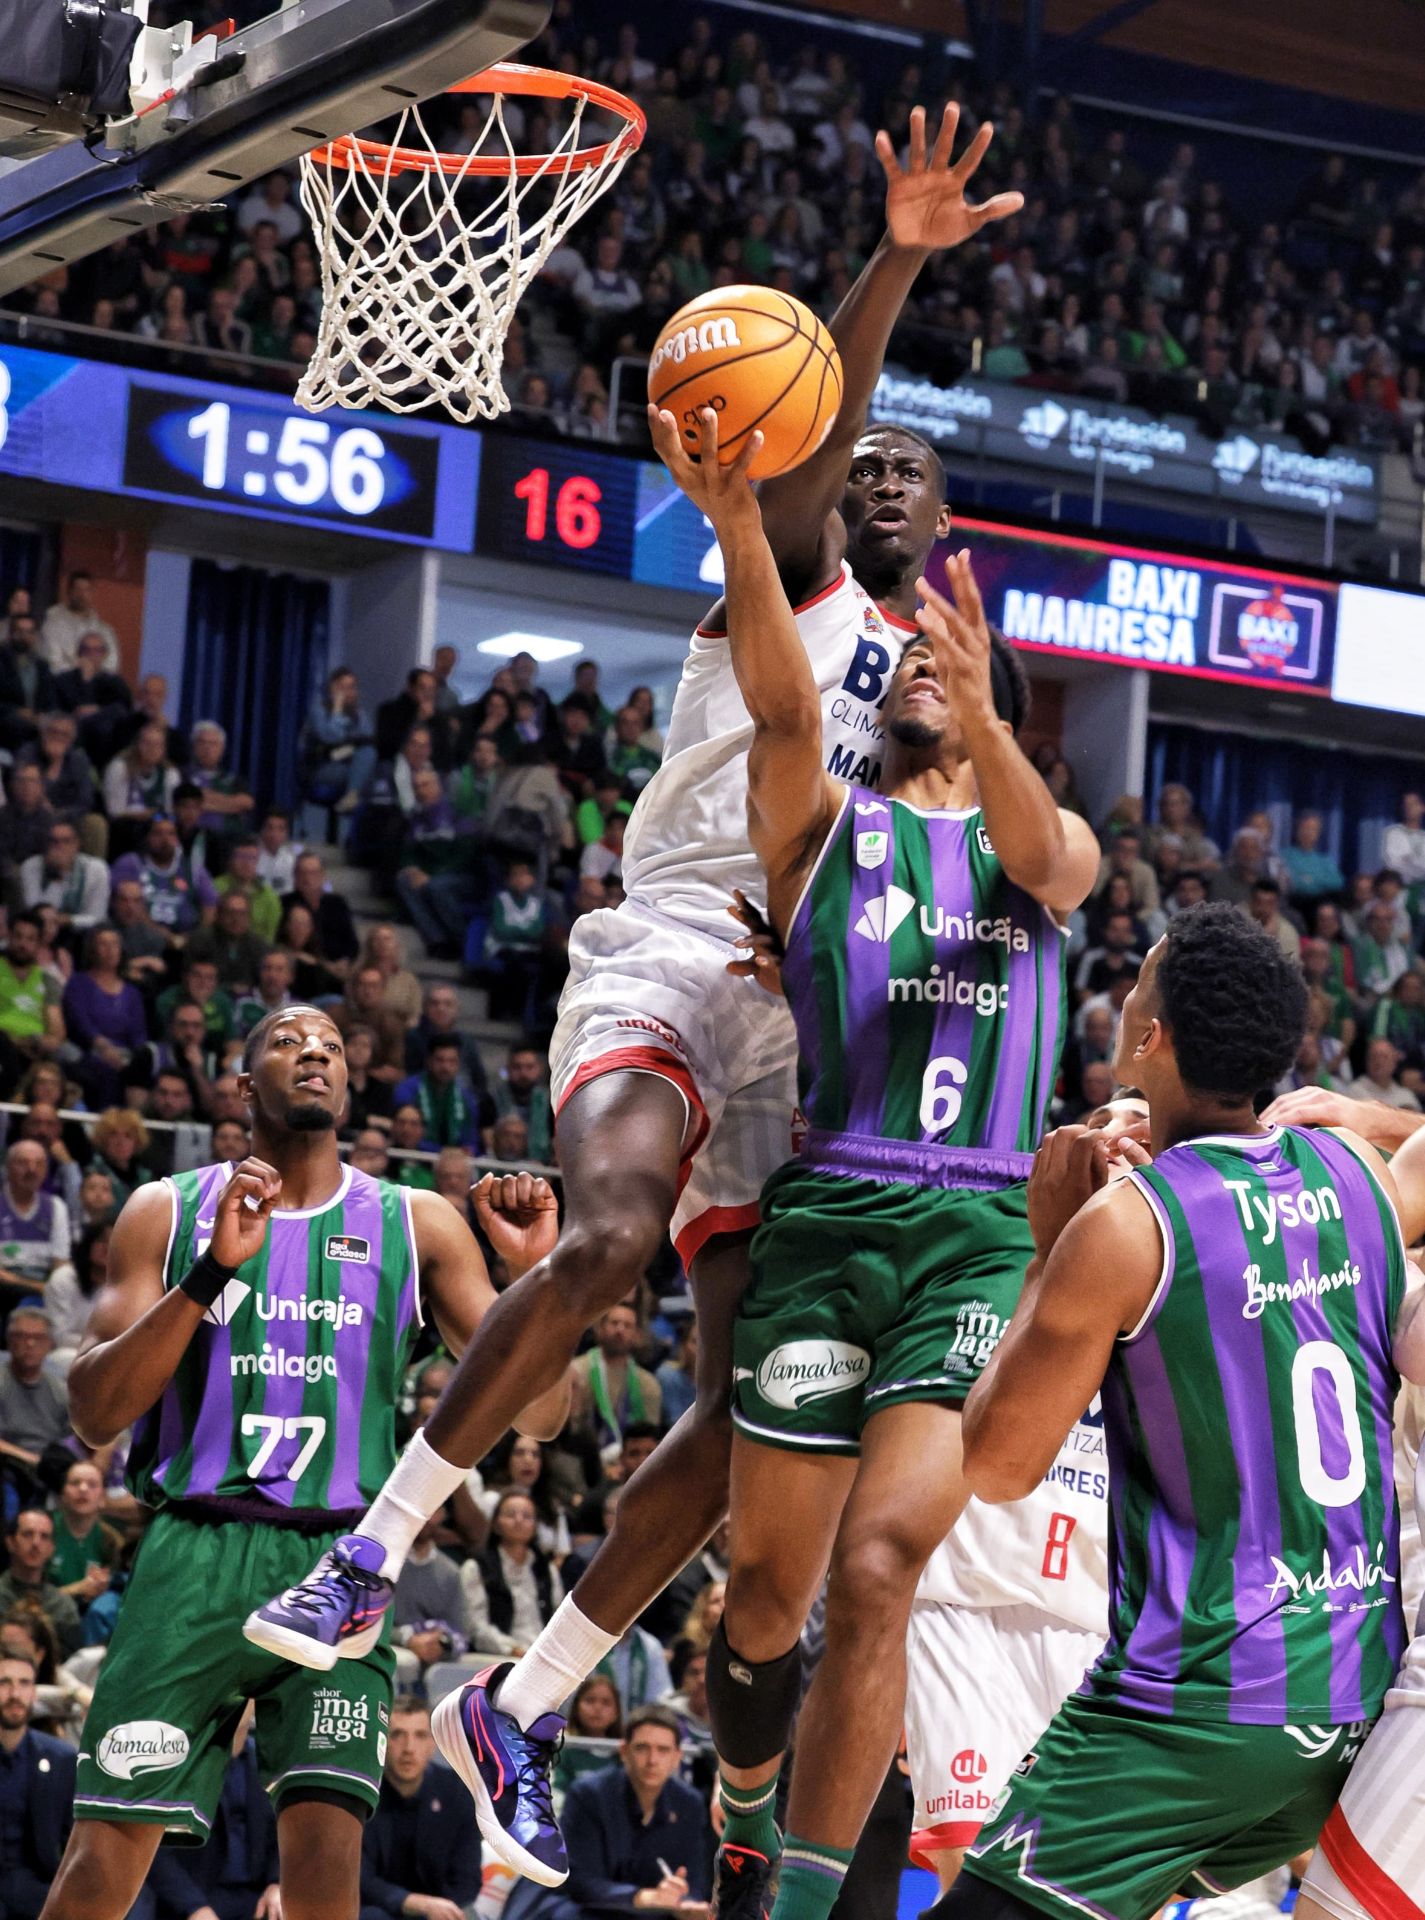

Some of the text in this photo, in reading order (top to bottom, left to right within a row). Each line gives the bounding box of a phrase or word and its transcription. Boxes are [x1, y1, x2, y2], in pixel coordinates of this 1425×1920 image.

[187, 402, 385, 516] 1:56
[514, 467, 603, 549] 16
[1108, 559, 1202, 620] BAXI
[1002, 589, 1197, 667] MANRESA
[1238, 613, 1299, 648] BAXI
[920, 905, 1029, 955] Unicaja
[919, 1056, 968, 1134] 6
[1223, 1180, 1342, 1246] Tyson
[256, 1292, 363, 1331] Unicaja
[241, 1413, 327, 1482] 77
[1291, 1340, 1367, 1508] 0
[1041, 1512, 1077, 1581] 8
[313, 1687, 342, 1698] sabor
[310, 1710, 367, 1743] laga
